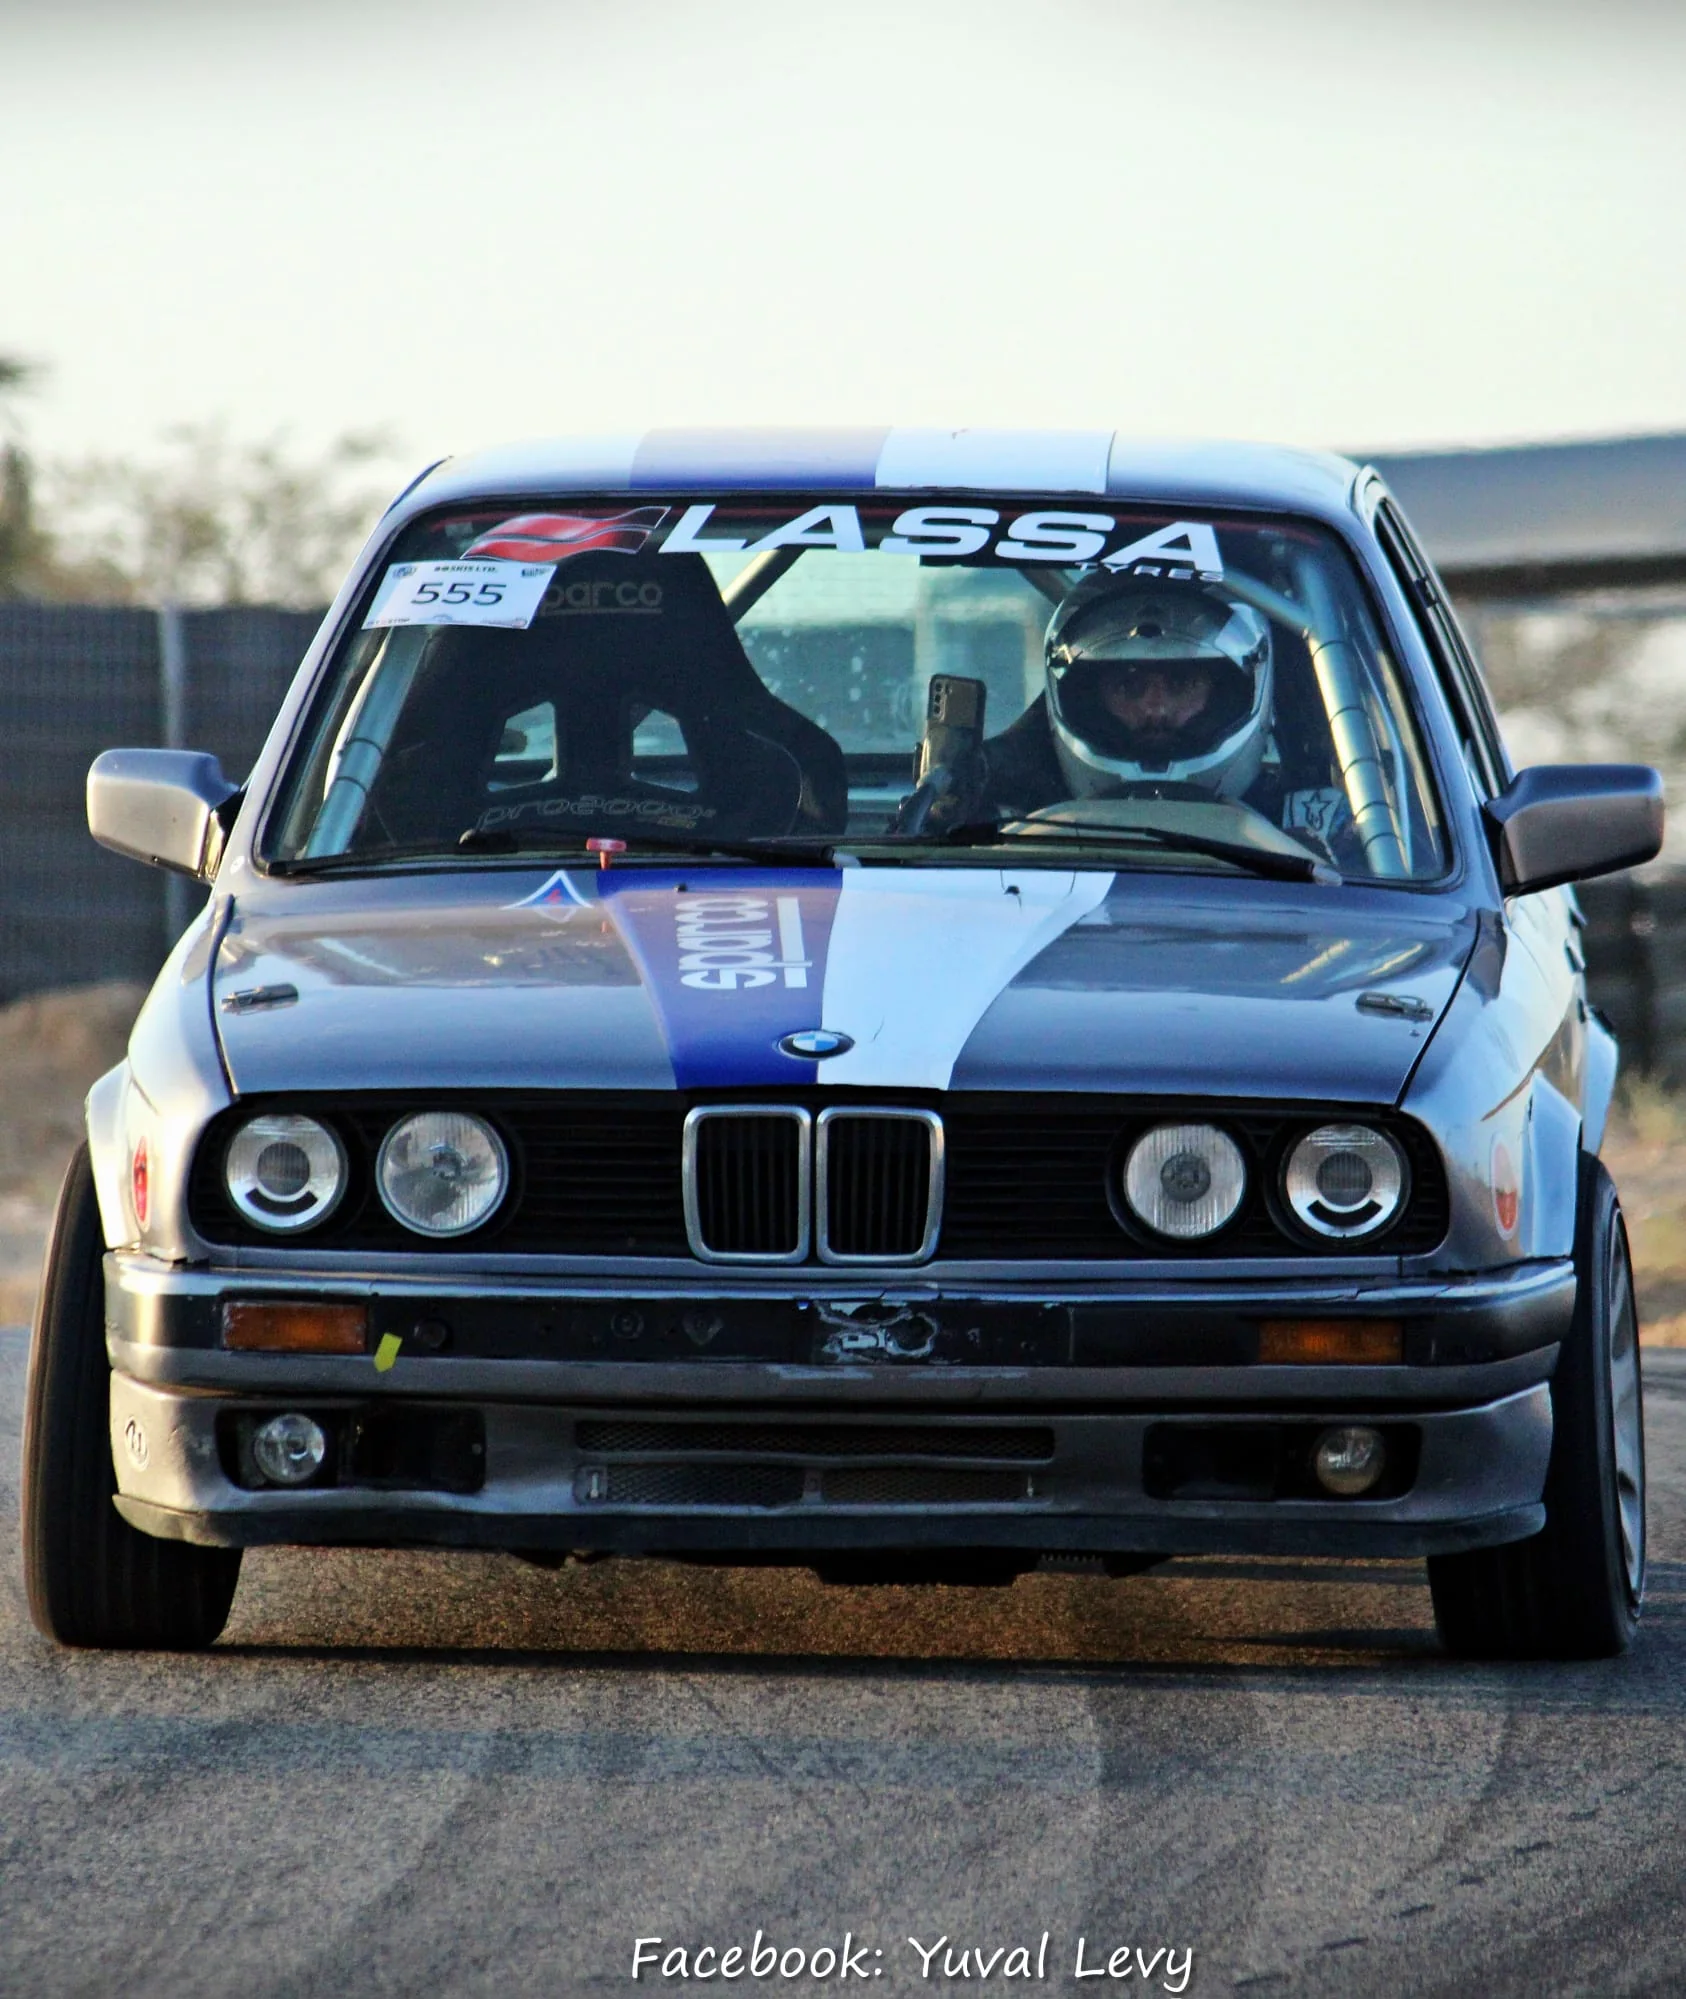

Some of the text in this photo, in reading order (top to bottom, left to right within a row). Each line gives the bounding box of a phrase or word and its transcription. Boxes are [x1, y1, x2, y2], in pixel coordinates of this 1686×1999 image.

[658, 504, 1223, 573] LASSA
[1074, 561, 1224, 582] TYRES
[411, 582, 506, 606] 555
[540, 580, 663, 616] parco
[674, 897, 812, 990] sparco
